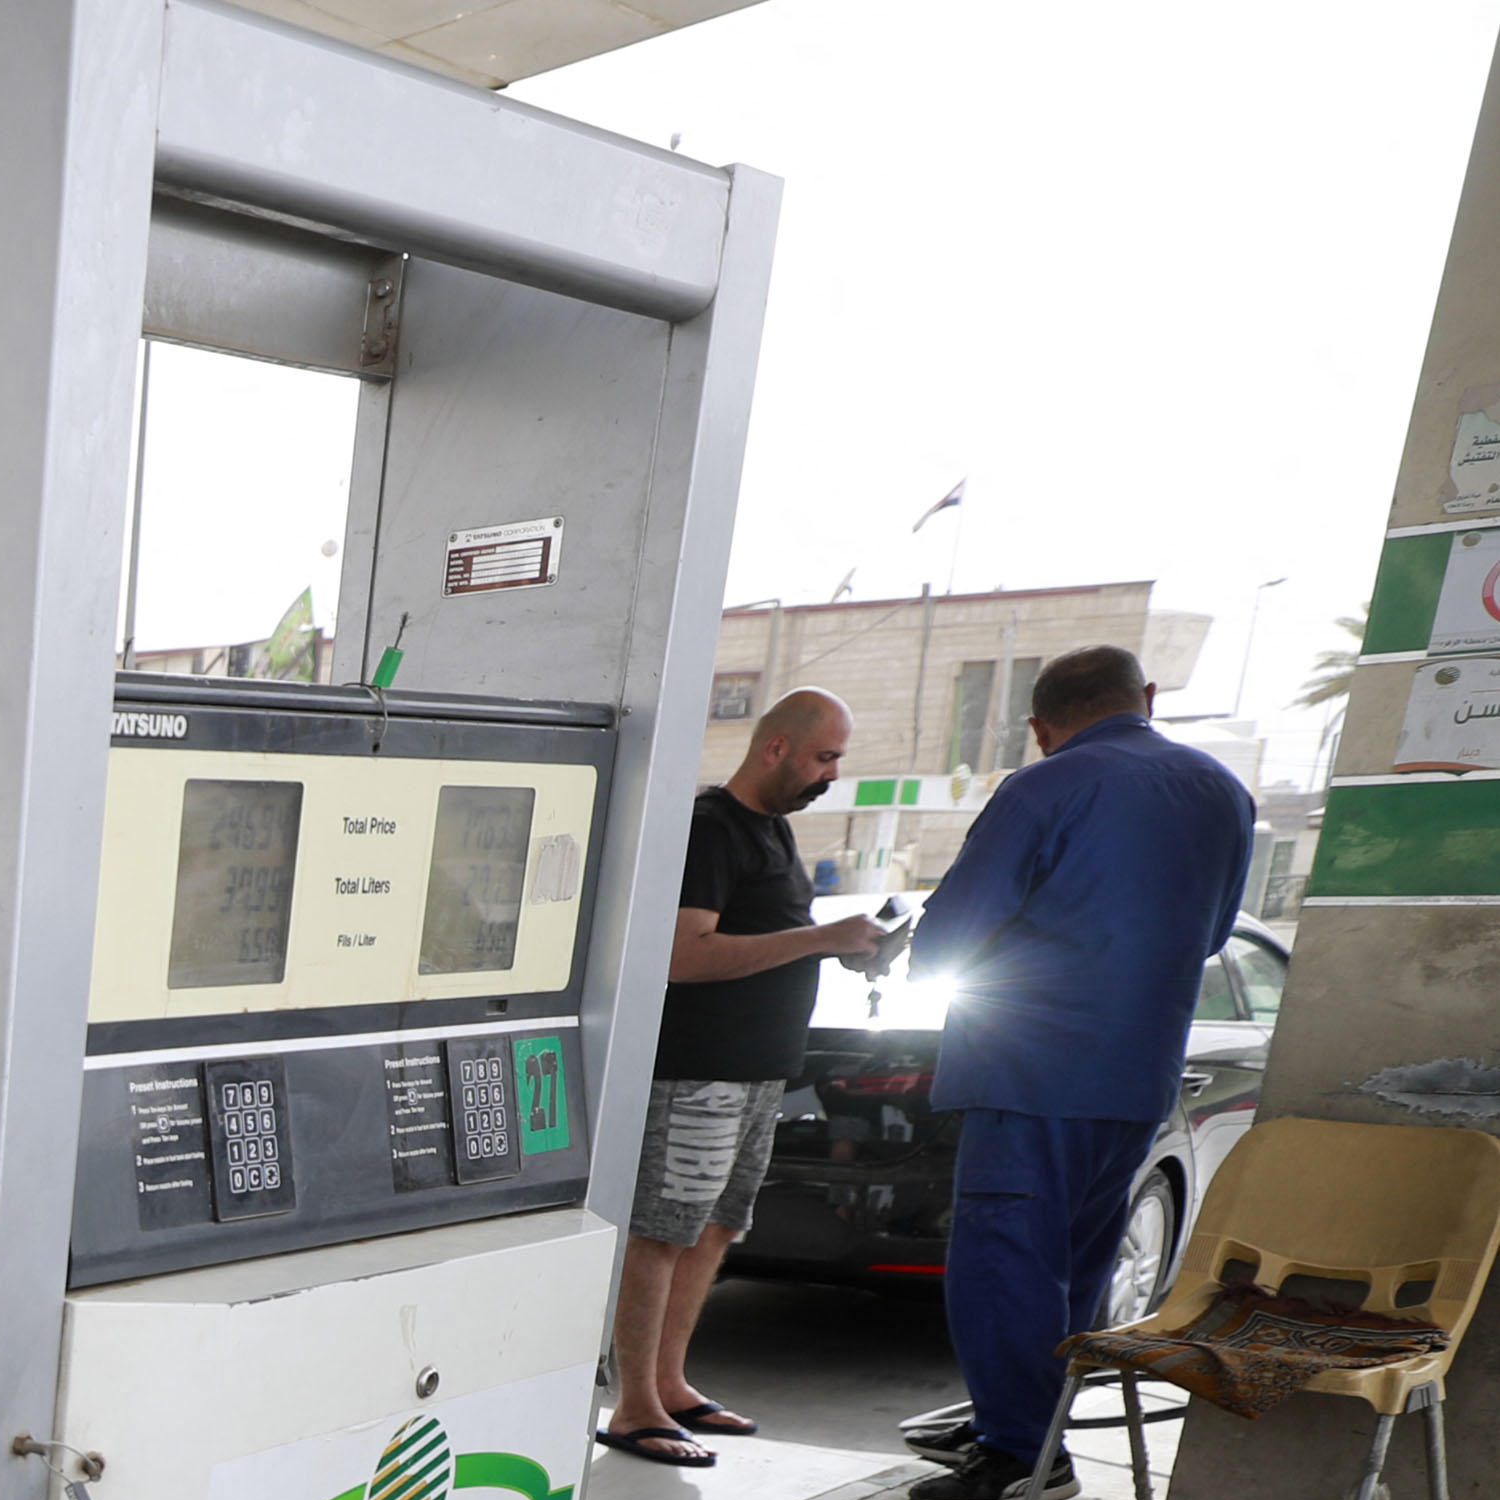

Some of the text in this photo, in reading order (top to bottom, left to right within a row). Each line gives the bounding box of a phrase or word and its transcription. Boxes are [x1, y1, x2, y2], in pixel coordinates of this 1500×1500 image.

[110, 712, 188, 739] TATSUNO
[343, 816, 397, 835] Total Price
[335, 877, 391, 895] Total Liters
[358, 933, 377, 946] Liter
[464, 1062, 499, 1080] 7 8 9
[129, 1078, 199, 1093] Preset Instructions
[525, 1051, 558, 1131] 27
[227, 1086, 269, 1105] 7 8 9
[466, 1087, 500, 1105] 4 5 6
[229, 1114, 271, 1132] 4 5 6
[468, 1112, 502, 1130] 1 2 3
[232, 1141, 274, 1160] 1 2 3
[483, 1138, 491, 1153] C
[661, 1111, 743, 1203] NBA
[234, 1170, 260, 1188] 0 C
